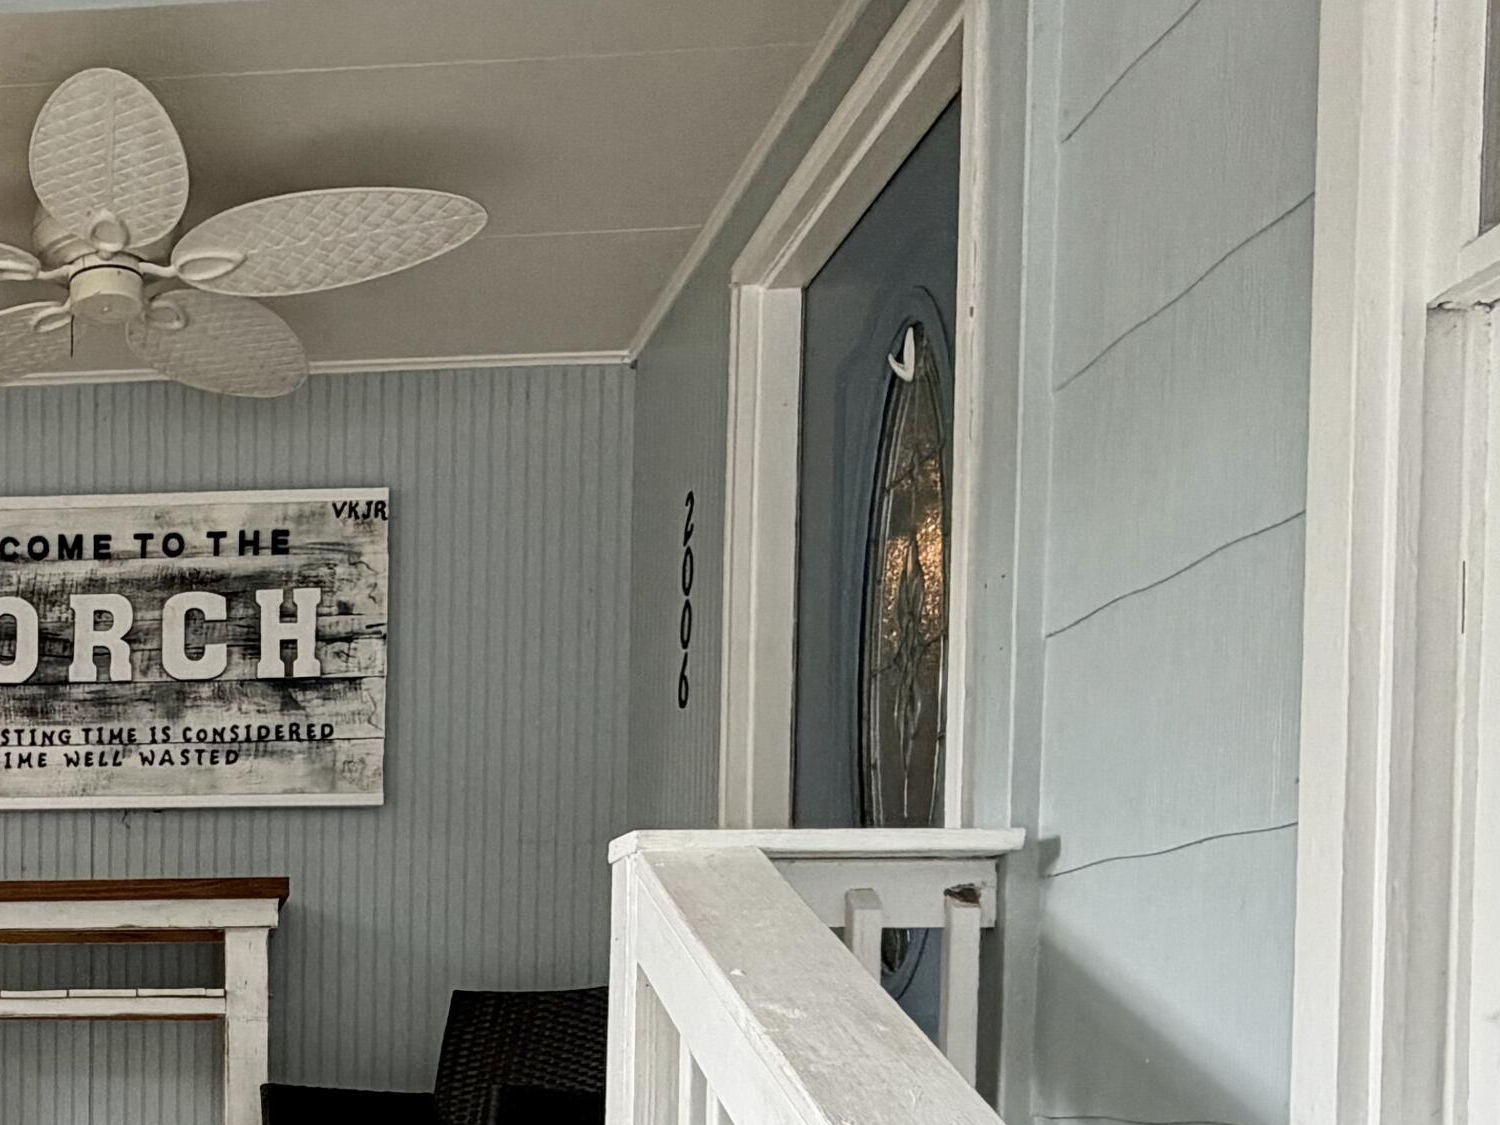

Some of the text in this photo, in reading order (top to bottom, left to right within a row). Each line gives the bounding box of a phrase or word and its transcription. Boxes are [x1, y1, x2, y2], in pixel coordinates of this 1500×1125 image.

[133, 531, 186, 559] TO
[206, 528, 292, 557] THE
[678, 490, 694, 709] 2006
[81, 726, 137, 746] TIME
[149, 725, 172, 745] IS
[182, 722, 335, 744] CONSIDERED
[63, 749, 123, 770] WELL
[140, 748, 241, 768] WASTED
